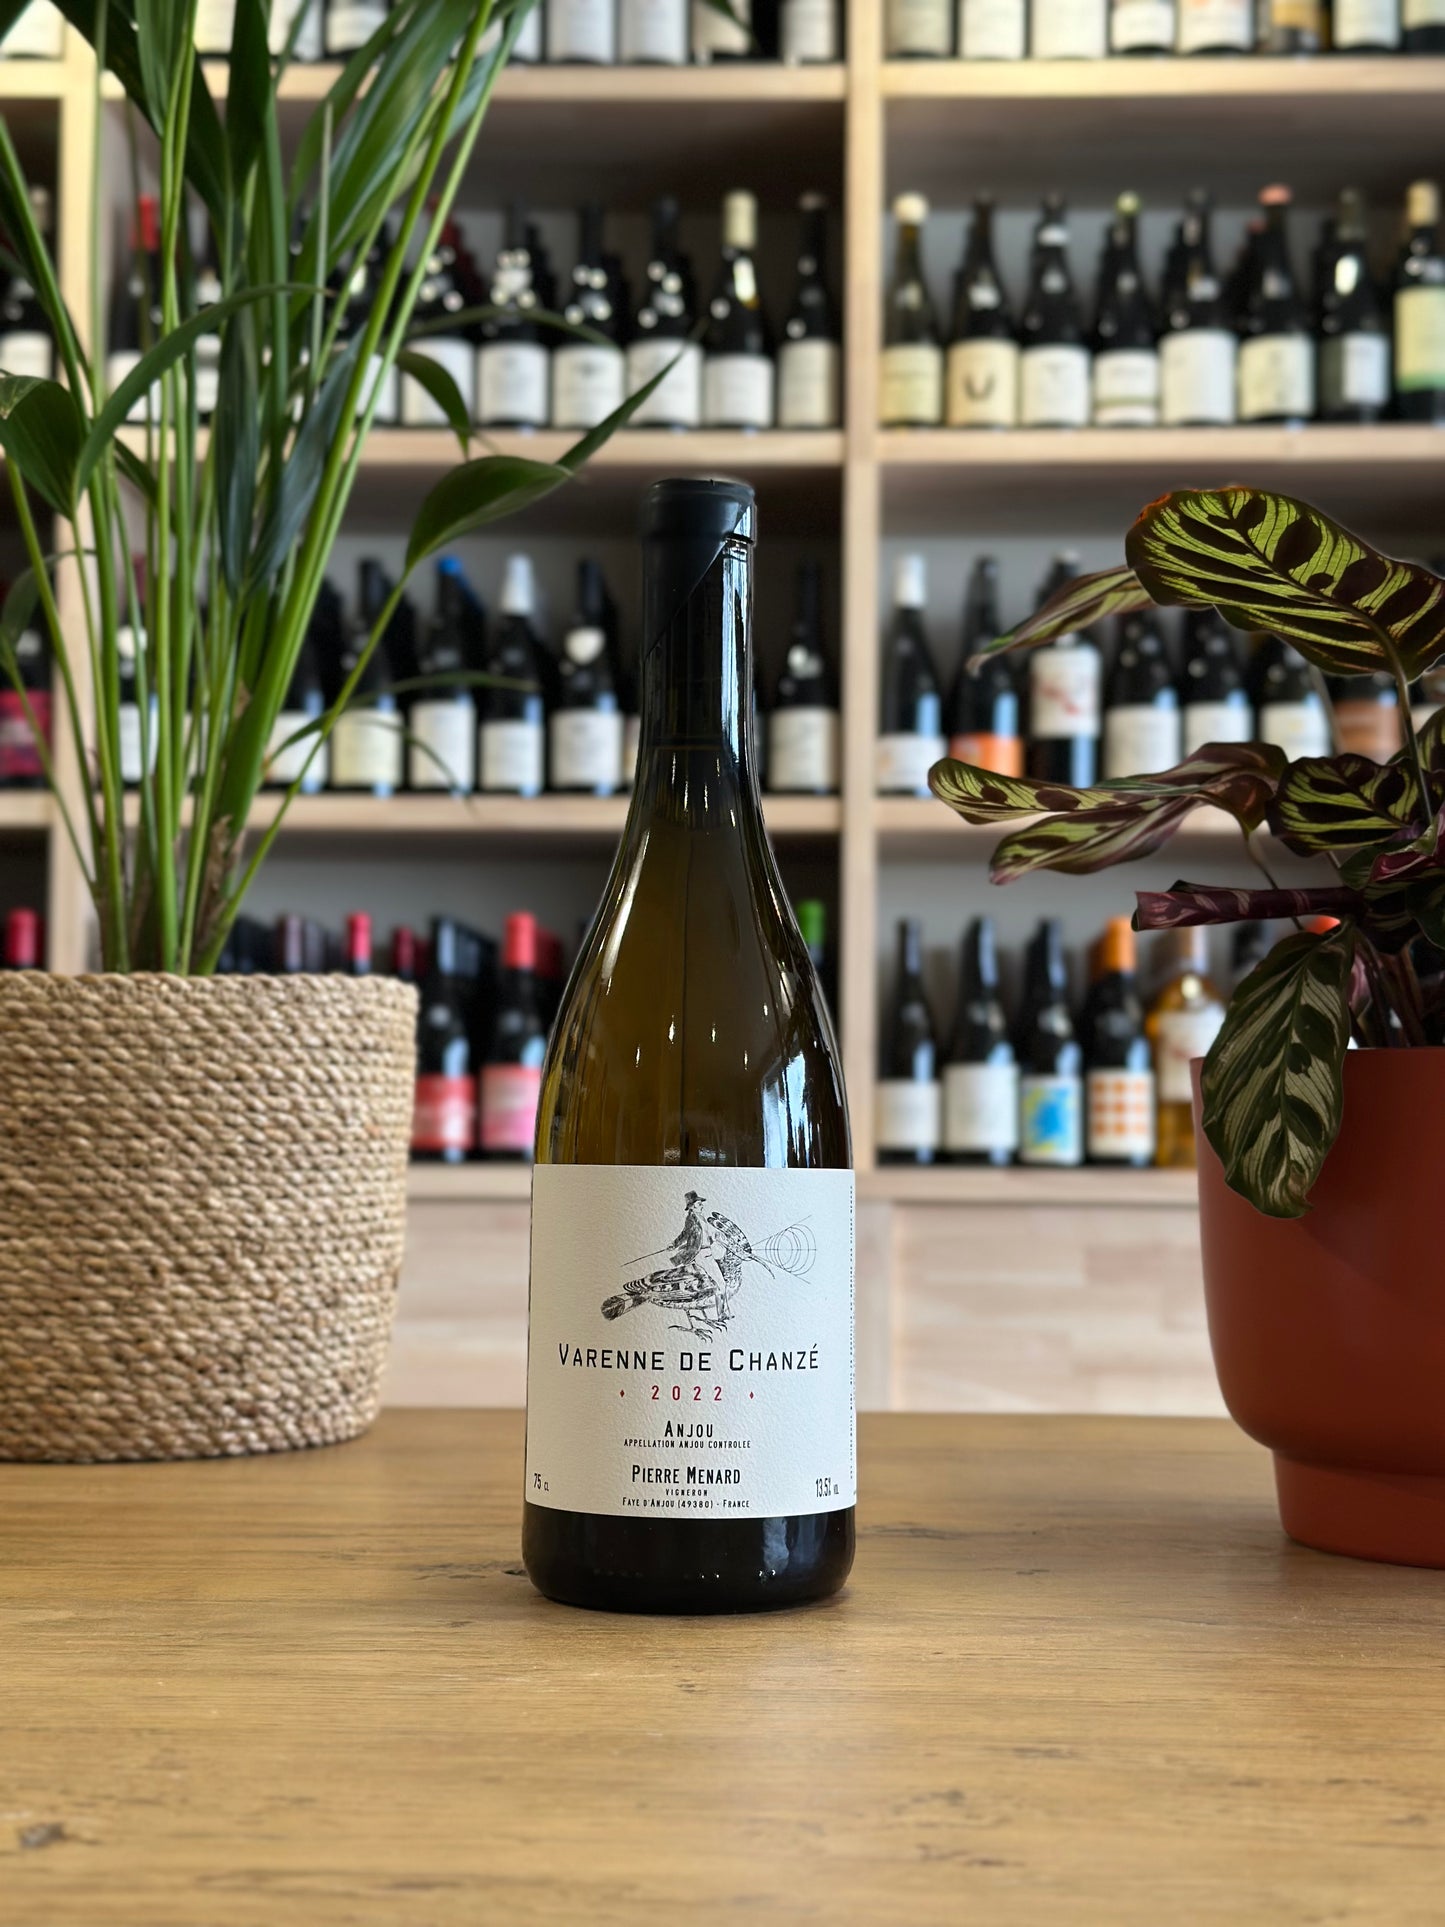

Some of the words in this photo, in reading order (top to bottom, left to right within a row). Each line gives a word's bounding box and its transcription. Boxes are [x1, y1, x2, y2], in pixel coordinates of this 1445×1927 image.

[559, 1343, 664, 1371] VARENNE
[680, 1352, 712, 1371] DE
[729, 1343, 819, 1371] CHANZÉ
[651, 1385, 722, 1401] 2022
[664, 1420, 714, 1438] ANJOU
[623, 1438, 675, 1448] APPELLATION
[678, 1439, 704, 1449] ANJOU
[708, 1440, 751, 1449] CONTROLEE
[533, 1472, 542, 1490] 75
[632, 1464, 680, 1484] PIERRE
[686, 1466, 741, 1485] MENARD
[665, 1488, 708, 1497] VIGNERON
[815, 1477, 832, 1498] 13.5%
[622, 1497, 640, 1507] FAYE
[677, 1499, 713, 1509] (49380)
[722, 1499, 750, 1508] FRANCE
